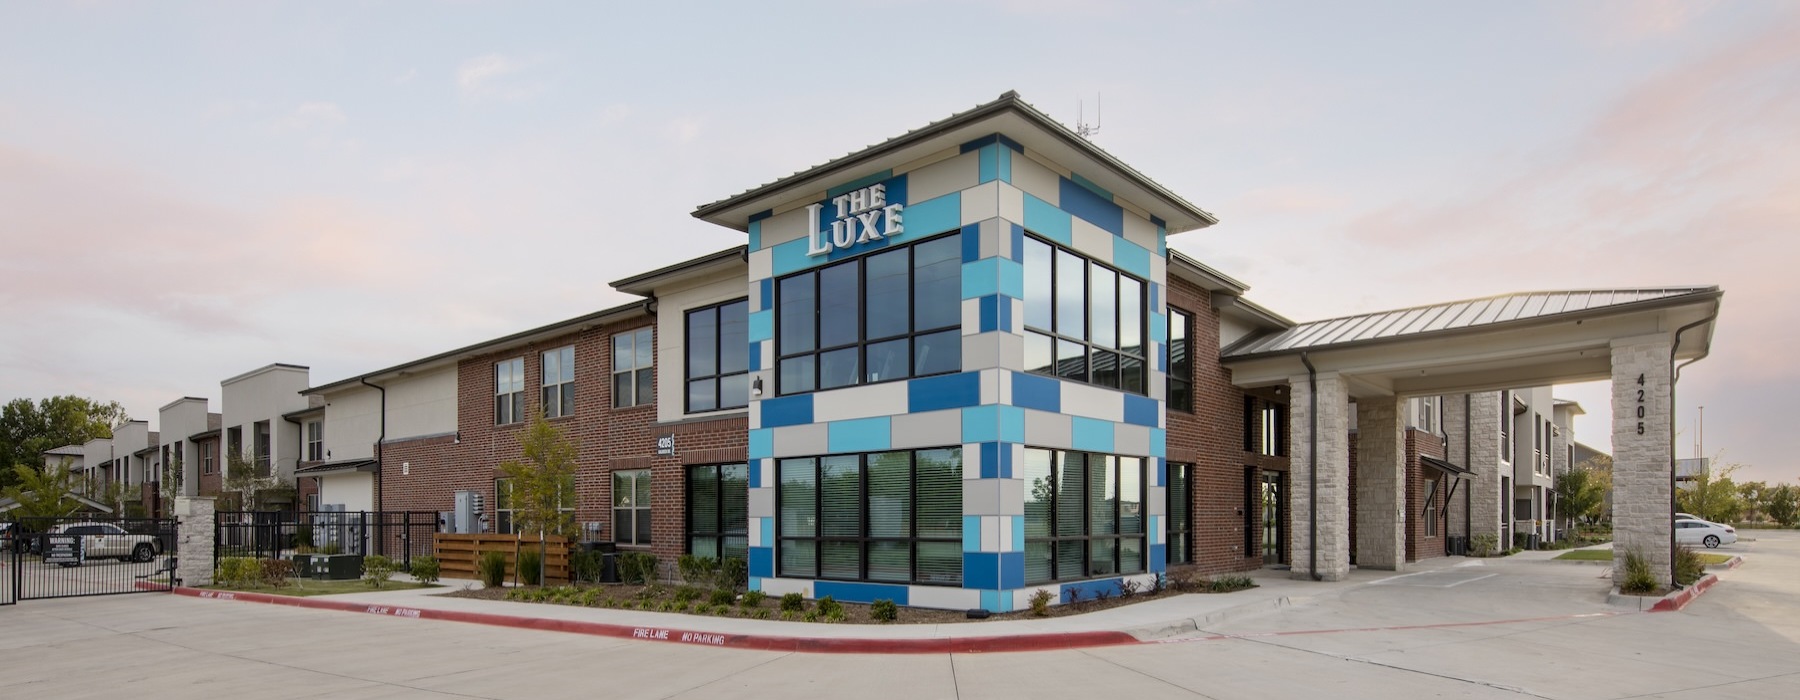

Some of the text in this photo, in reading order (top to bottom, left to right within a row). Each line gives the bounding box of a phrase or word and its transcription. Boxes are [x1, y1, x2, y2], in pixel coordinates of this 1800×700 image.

[832, 183, 886, 219] THE
[805, 203, 904, 257] LUXE
[1637, 373, 1645, 435] 4205
[658, 437, 671, 448] 4205
[633, 628, 725, 645] FIRE LANE NO PARKING
